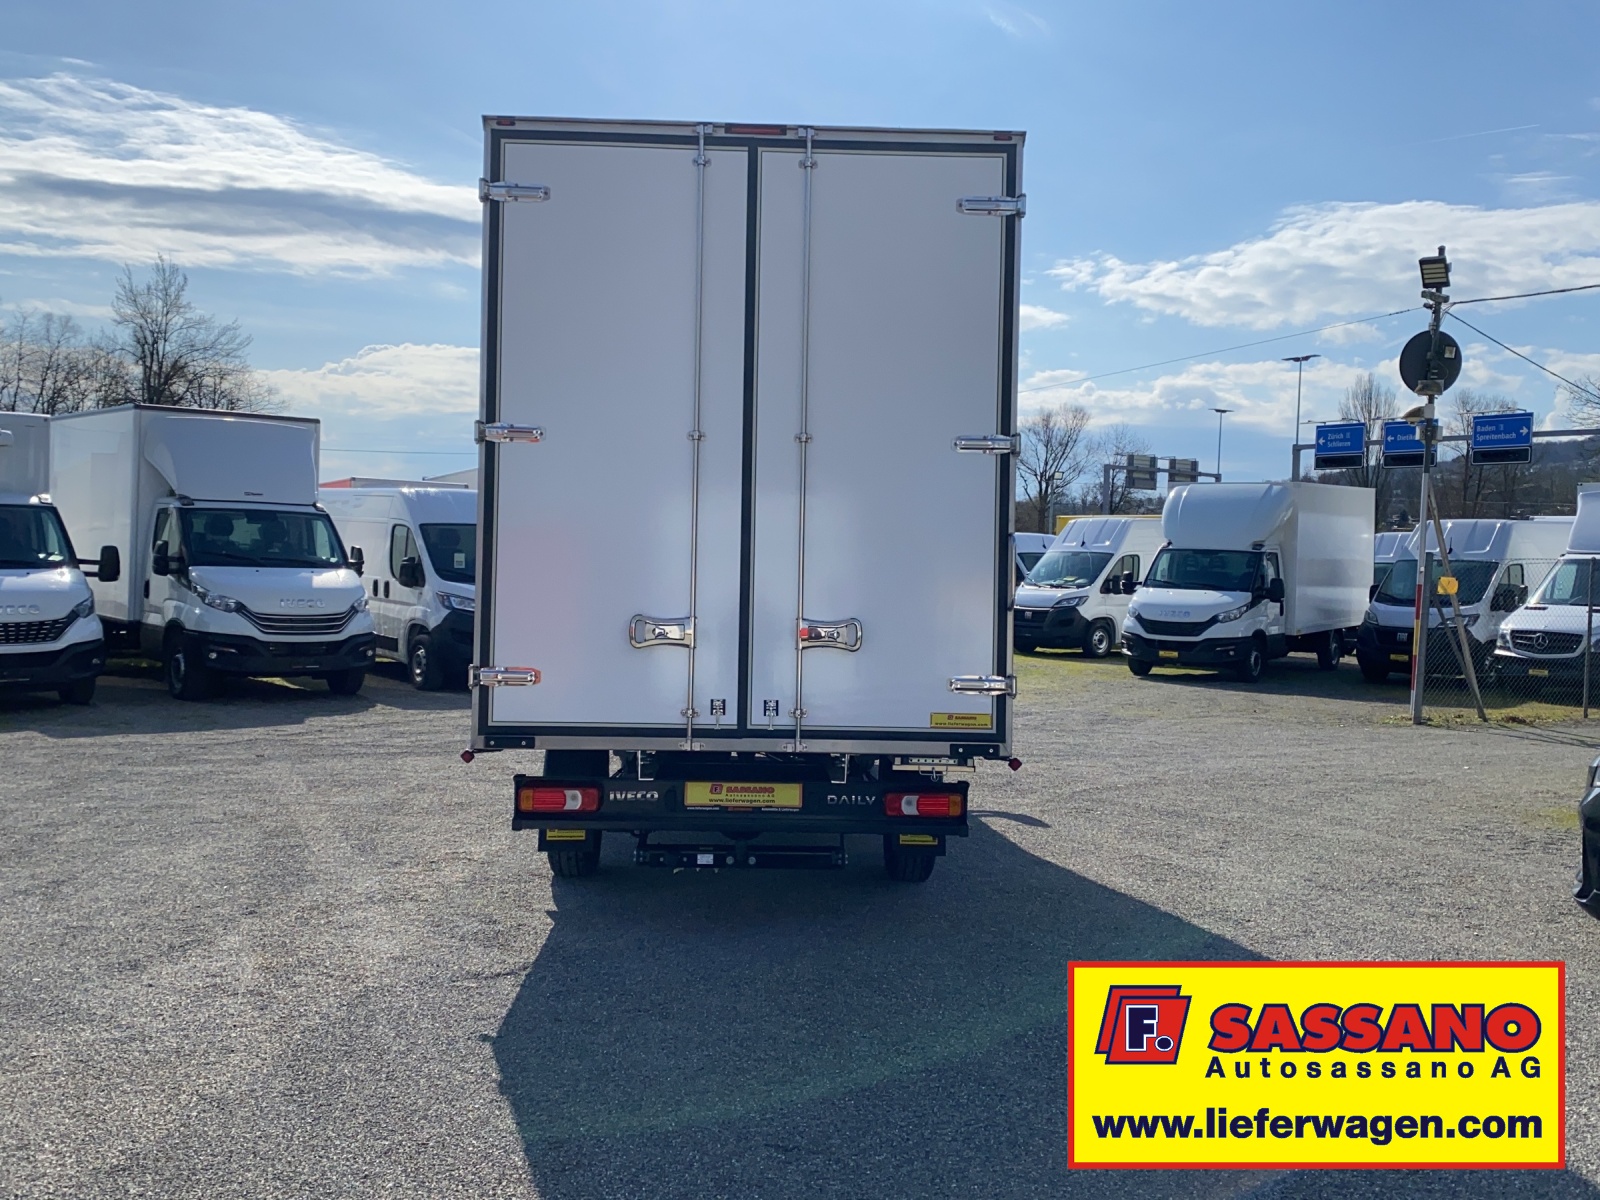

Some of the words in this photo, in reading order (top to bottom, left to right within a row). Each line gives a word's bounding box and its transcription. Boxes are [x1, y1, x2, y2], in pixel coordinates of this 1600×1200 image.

[1327, 432, 1344, 440] Zürich
[1476, 432, 1517, 441] Spreitenbach
[280, 599, 326, 608] IVECO
[609, 790, 659, 800] IVECO
[827, 795, 876, 805] DAILY
